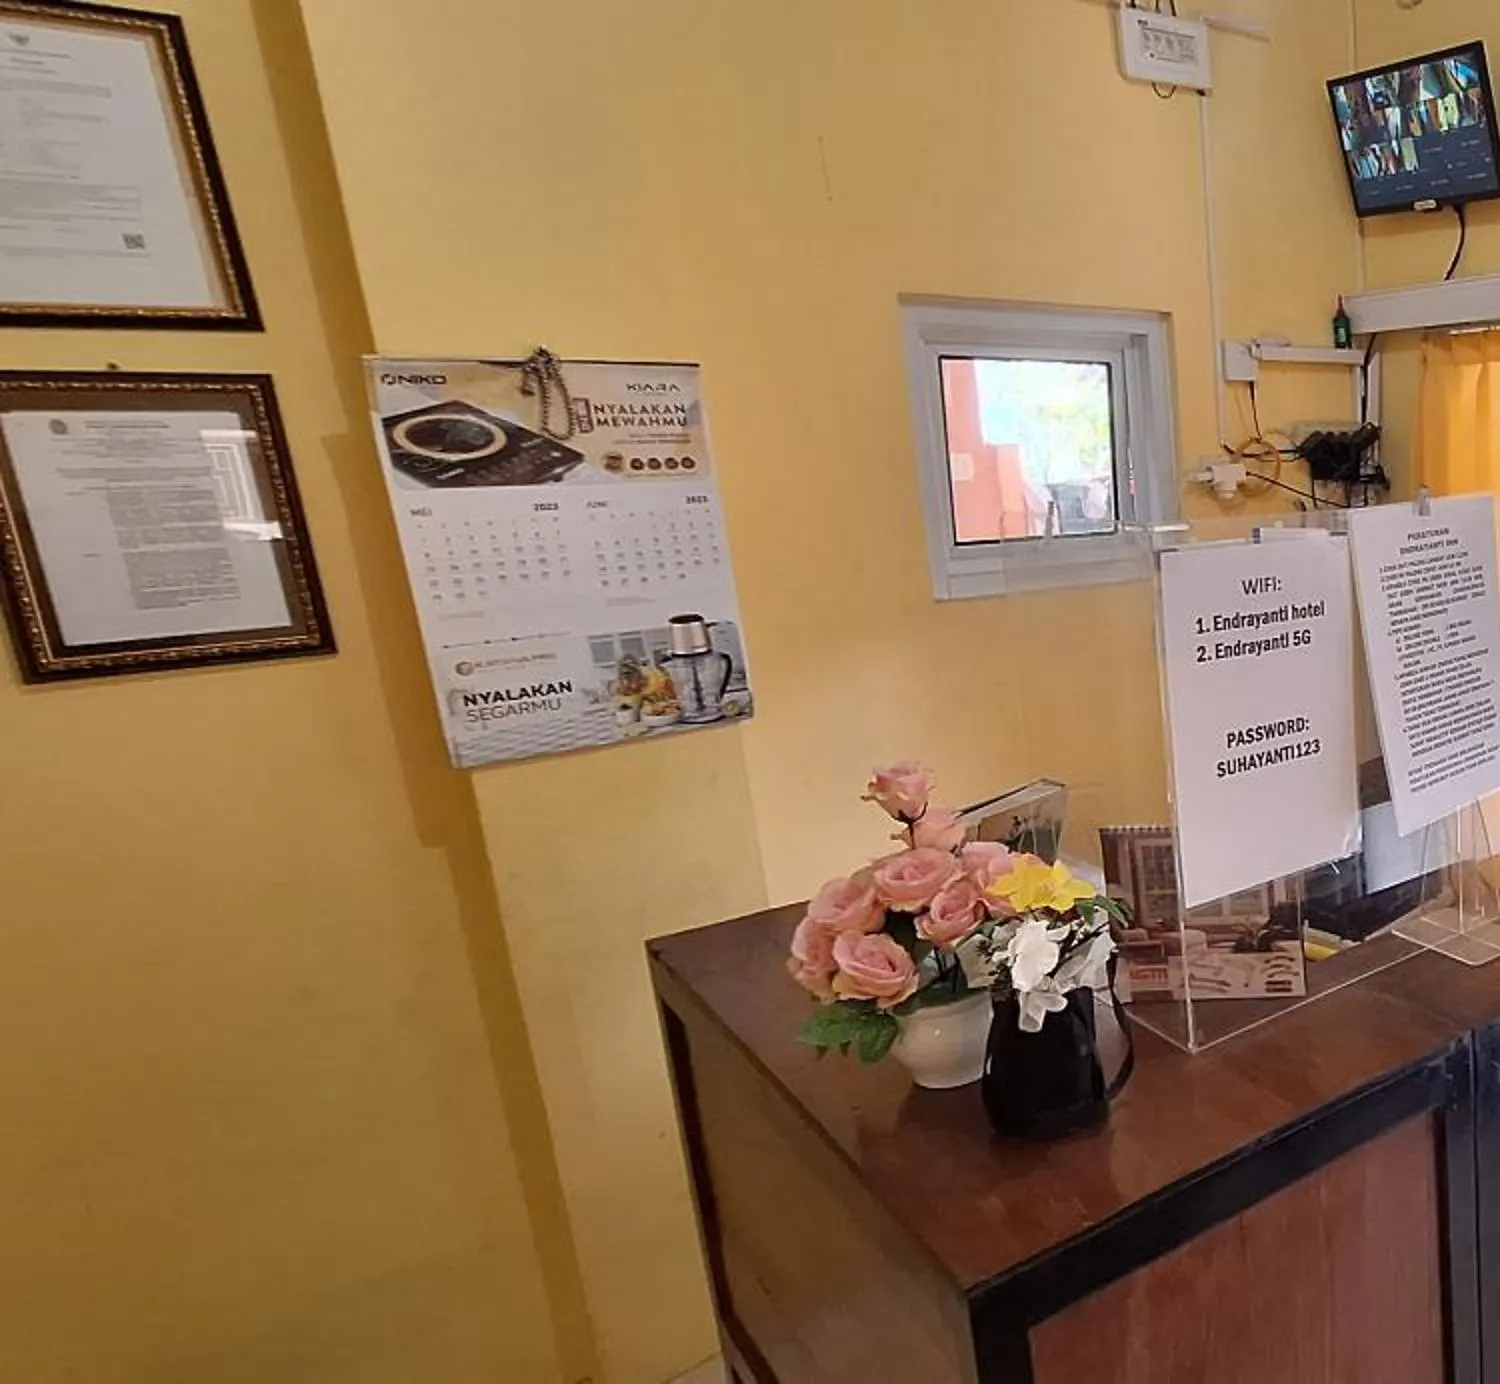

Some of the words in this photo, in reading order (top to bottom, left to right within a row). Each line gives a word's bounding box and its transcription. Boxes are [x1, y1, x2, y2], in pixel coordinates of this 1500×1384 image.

[397, 375, 447, 385] NIKO
[626, 383, 681, 392] KIARA
[593, 403, 686, 415] NYALAKAN
[596, 416, 687, 427] MEWAHMU
[1242, 576, 1281, 595] WIFI:
[1195, 617, 1211, 634] 1.
[1213, 605, 1289, 631] Endrayanti
[1291, 600, 1325, 620] hotel
[1196, 645, 1212, 662] 2.
[1215, 632, 1289, 659] Endrayanti
[1292, 629, 1311, 647] 5G
[463, 680, 573, 707] NYALAKAN
[465, 698, 562, 723] SEGARMU
[1227, 717, 1309, 749] PASSWORD:
[1216, 738, 1321, 778] SUHAYANTI123
